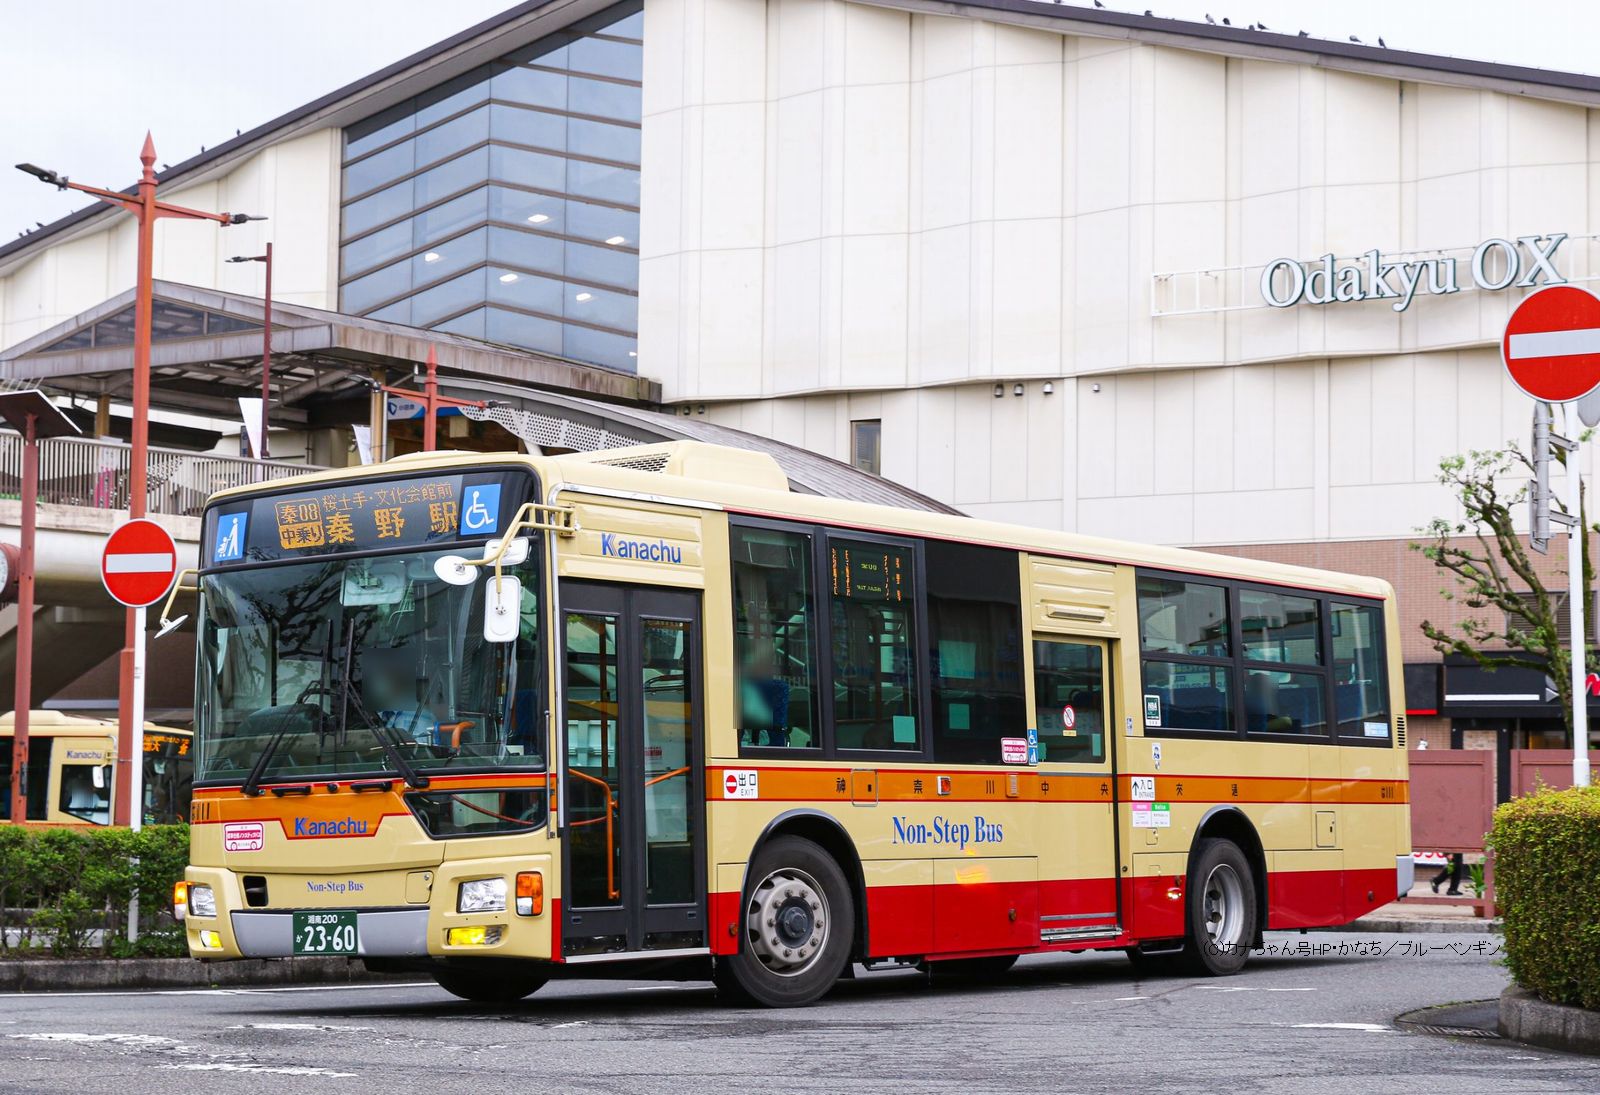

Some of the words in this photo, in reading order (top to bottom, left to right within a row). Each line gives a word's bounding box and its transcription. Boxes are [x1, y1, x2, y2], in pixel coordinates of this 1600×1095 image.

[1260, 249, 1459, 312] Odakyu
[1472, 233, 1568, 291] OX
[601, 532, 682, 563] Kanachu
[738, 772, 756, 787] 出口
[1140, 779, 1153, 790] 入口
[740, 788, 754, 797] EXIT
[295, 817, 367, 836] Kanachu
[892, 815, 970, 850] Non-Step
[974, 816, 1004, 843] Bus
[307, 881, 346, 894] Non-Step
[348, 880, 364, 891] Bus
[304, 925, 355, 951] 23-60
